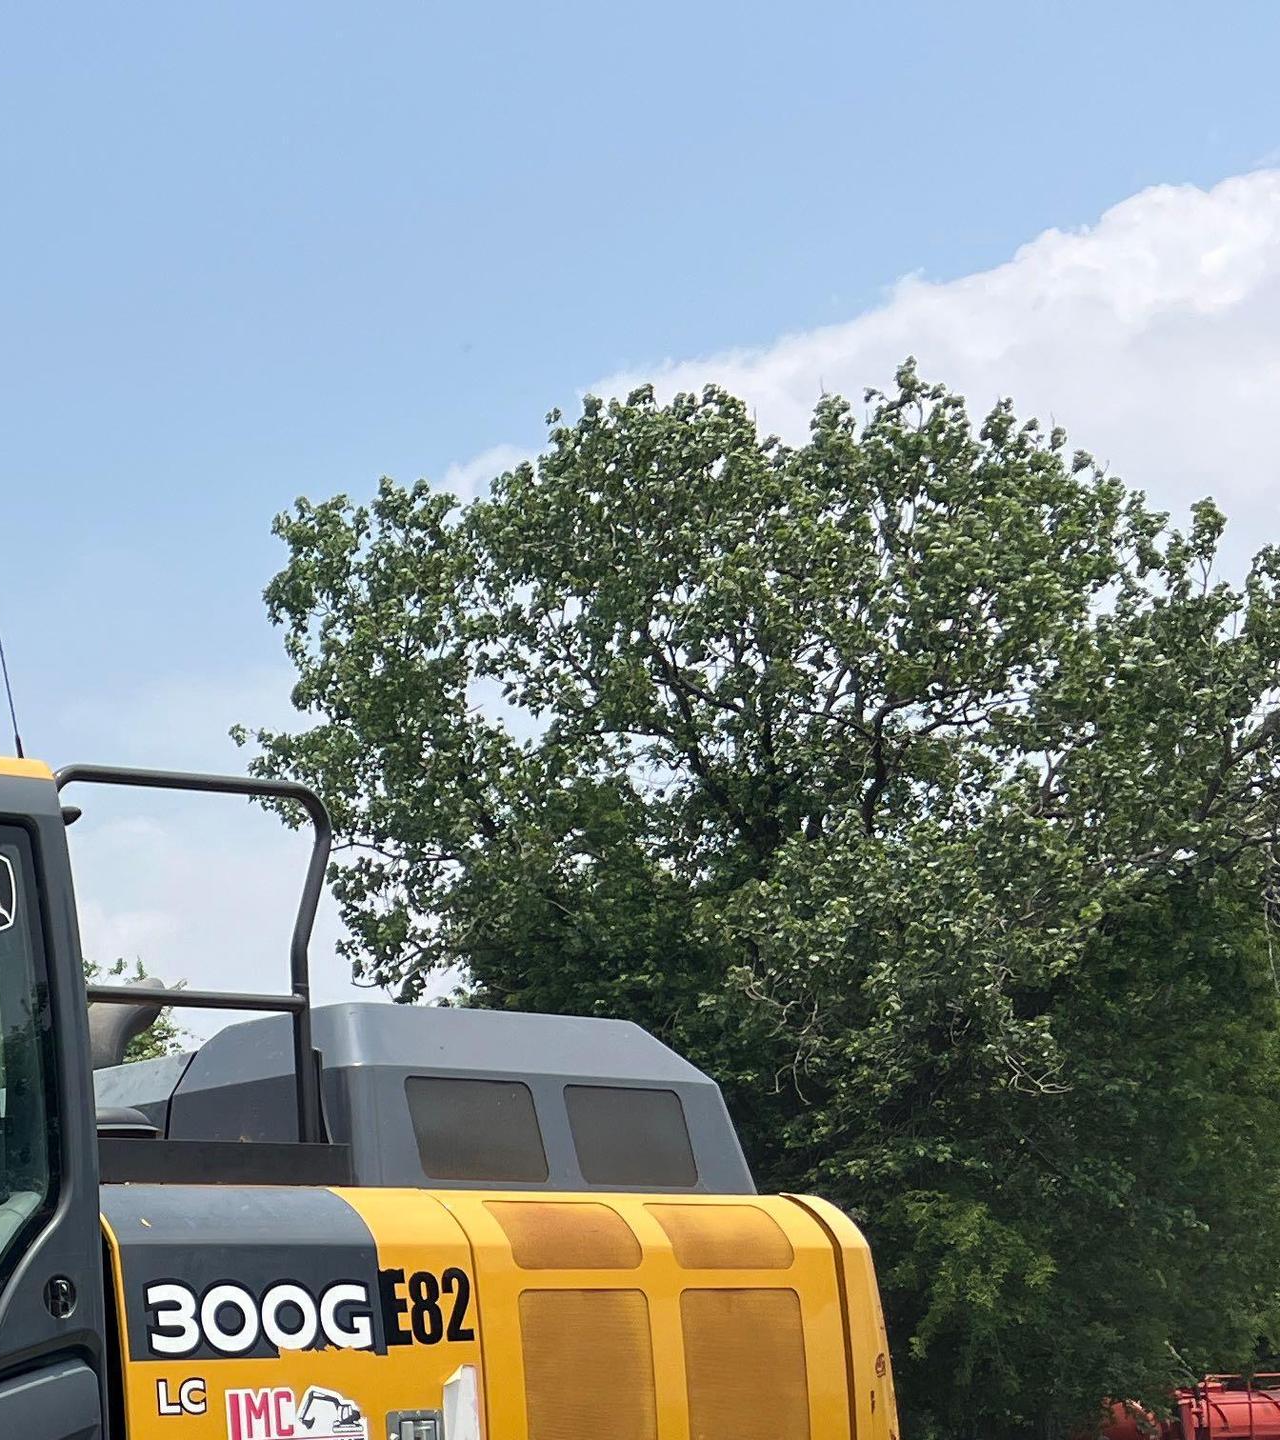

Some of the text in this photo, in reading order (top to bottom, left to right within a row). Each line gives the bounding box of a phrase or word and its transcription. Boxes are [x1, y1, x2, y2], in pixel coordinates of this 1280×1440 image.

[145, 1282, 374, 1356] 300G
[379, 1267, 475, 1346] E82
[156, 1378, 208, 1416] LC
